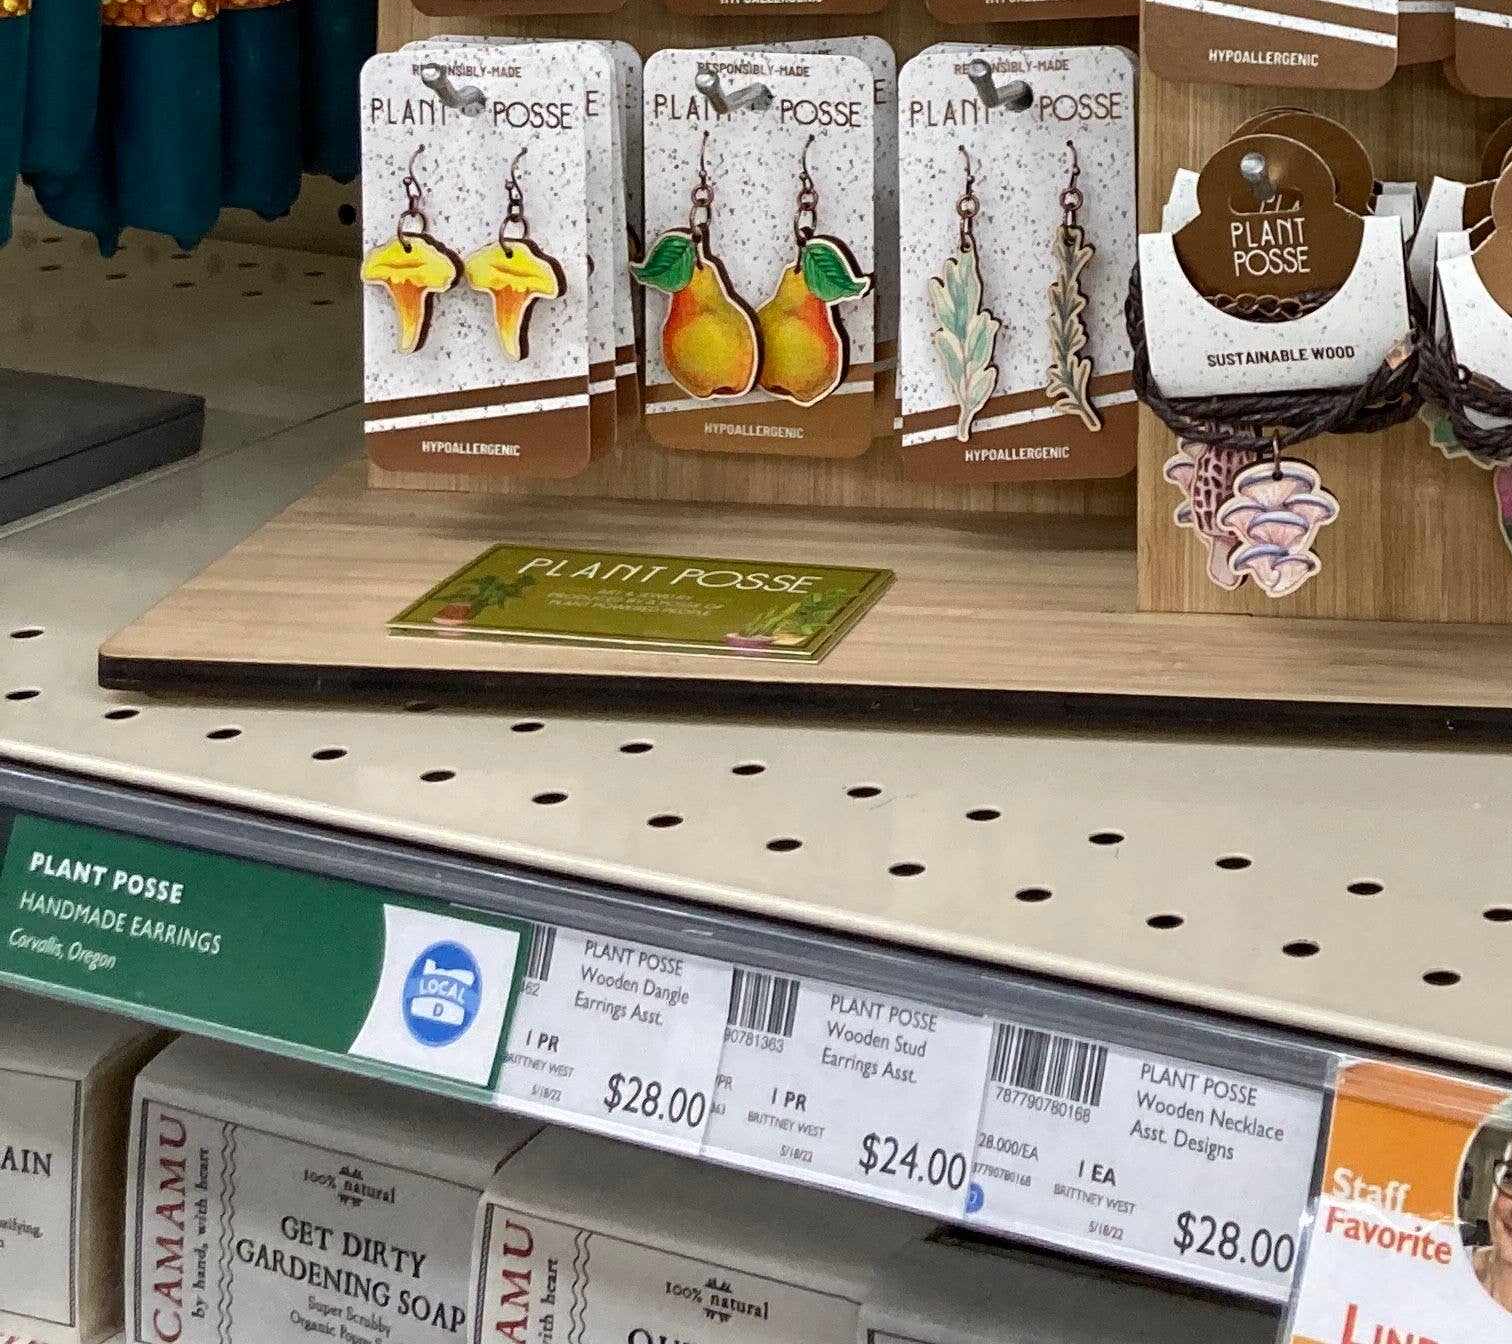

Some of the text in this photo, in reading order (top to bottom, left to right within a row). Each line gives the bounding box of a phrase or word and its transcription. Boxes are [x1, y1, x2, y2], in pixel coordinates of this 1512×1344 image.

[1231, 218, 1305, 249] PLANT
[1233, 246, 1311, 278] POSSE
[1206, 345, 1356, 368] SUSTAINABLE WOOD
[518, 557, 824, 594] PLANT POSSE
[28, 851, 184, 905] PLANT POSSE
[20, 890, 223, 955] HANDMADE EARRINGS
[9, 927, 118, 971] Corvallis, Oregon
[583, 938, 684, 977] PLANT POSSE
[419, 977, 467, 1004] LOCAL
[580, 964, 690, 1007] Wooden Dangle
[574, 989, 664, 1026] Earrings Asst.
[829, 992, 939, 1034] PLANT POSSE
[537, 1031, 560, 1054] PR
[827, 1019, 928, 1059] Wooden Stud
[821, 1045, 919, 1085] Earrings Asst.
[1138, 1062, 1259, 1108] PLANT POSSE
[603, 1072, 707, 1128] $28.00
[784, 1090, 807, 1112] PR
[1136, 1089, 1205, 1125] Wooden
[1210, 1111, 1286, 1143] Necklace
[857, 1130, 968, 1192] $24.00
[1129, 1117, 1168, 1146] Asst.
[1173, 1129, 1236, 1163] Designs
[303, 1168, 397, 1205] 100% natural
[1091, 1162, 1117, 1188] EA
[1331, 1167, 1412, 1213] Staff
[153, 1113, 187, 1343] CAMAMU
[280, 1215, 427, 1279] GET DIRTY
[1173, 1210, 1297, 1275] $28.00
[1324, 1204, 1453, 1267] Favorite
[192, 1294, 209, 1319] by
[236, 1238, 467, 1333] GARDENING SOAP
[664, 1281, 769, 1321] 100% natural
